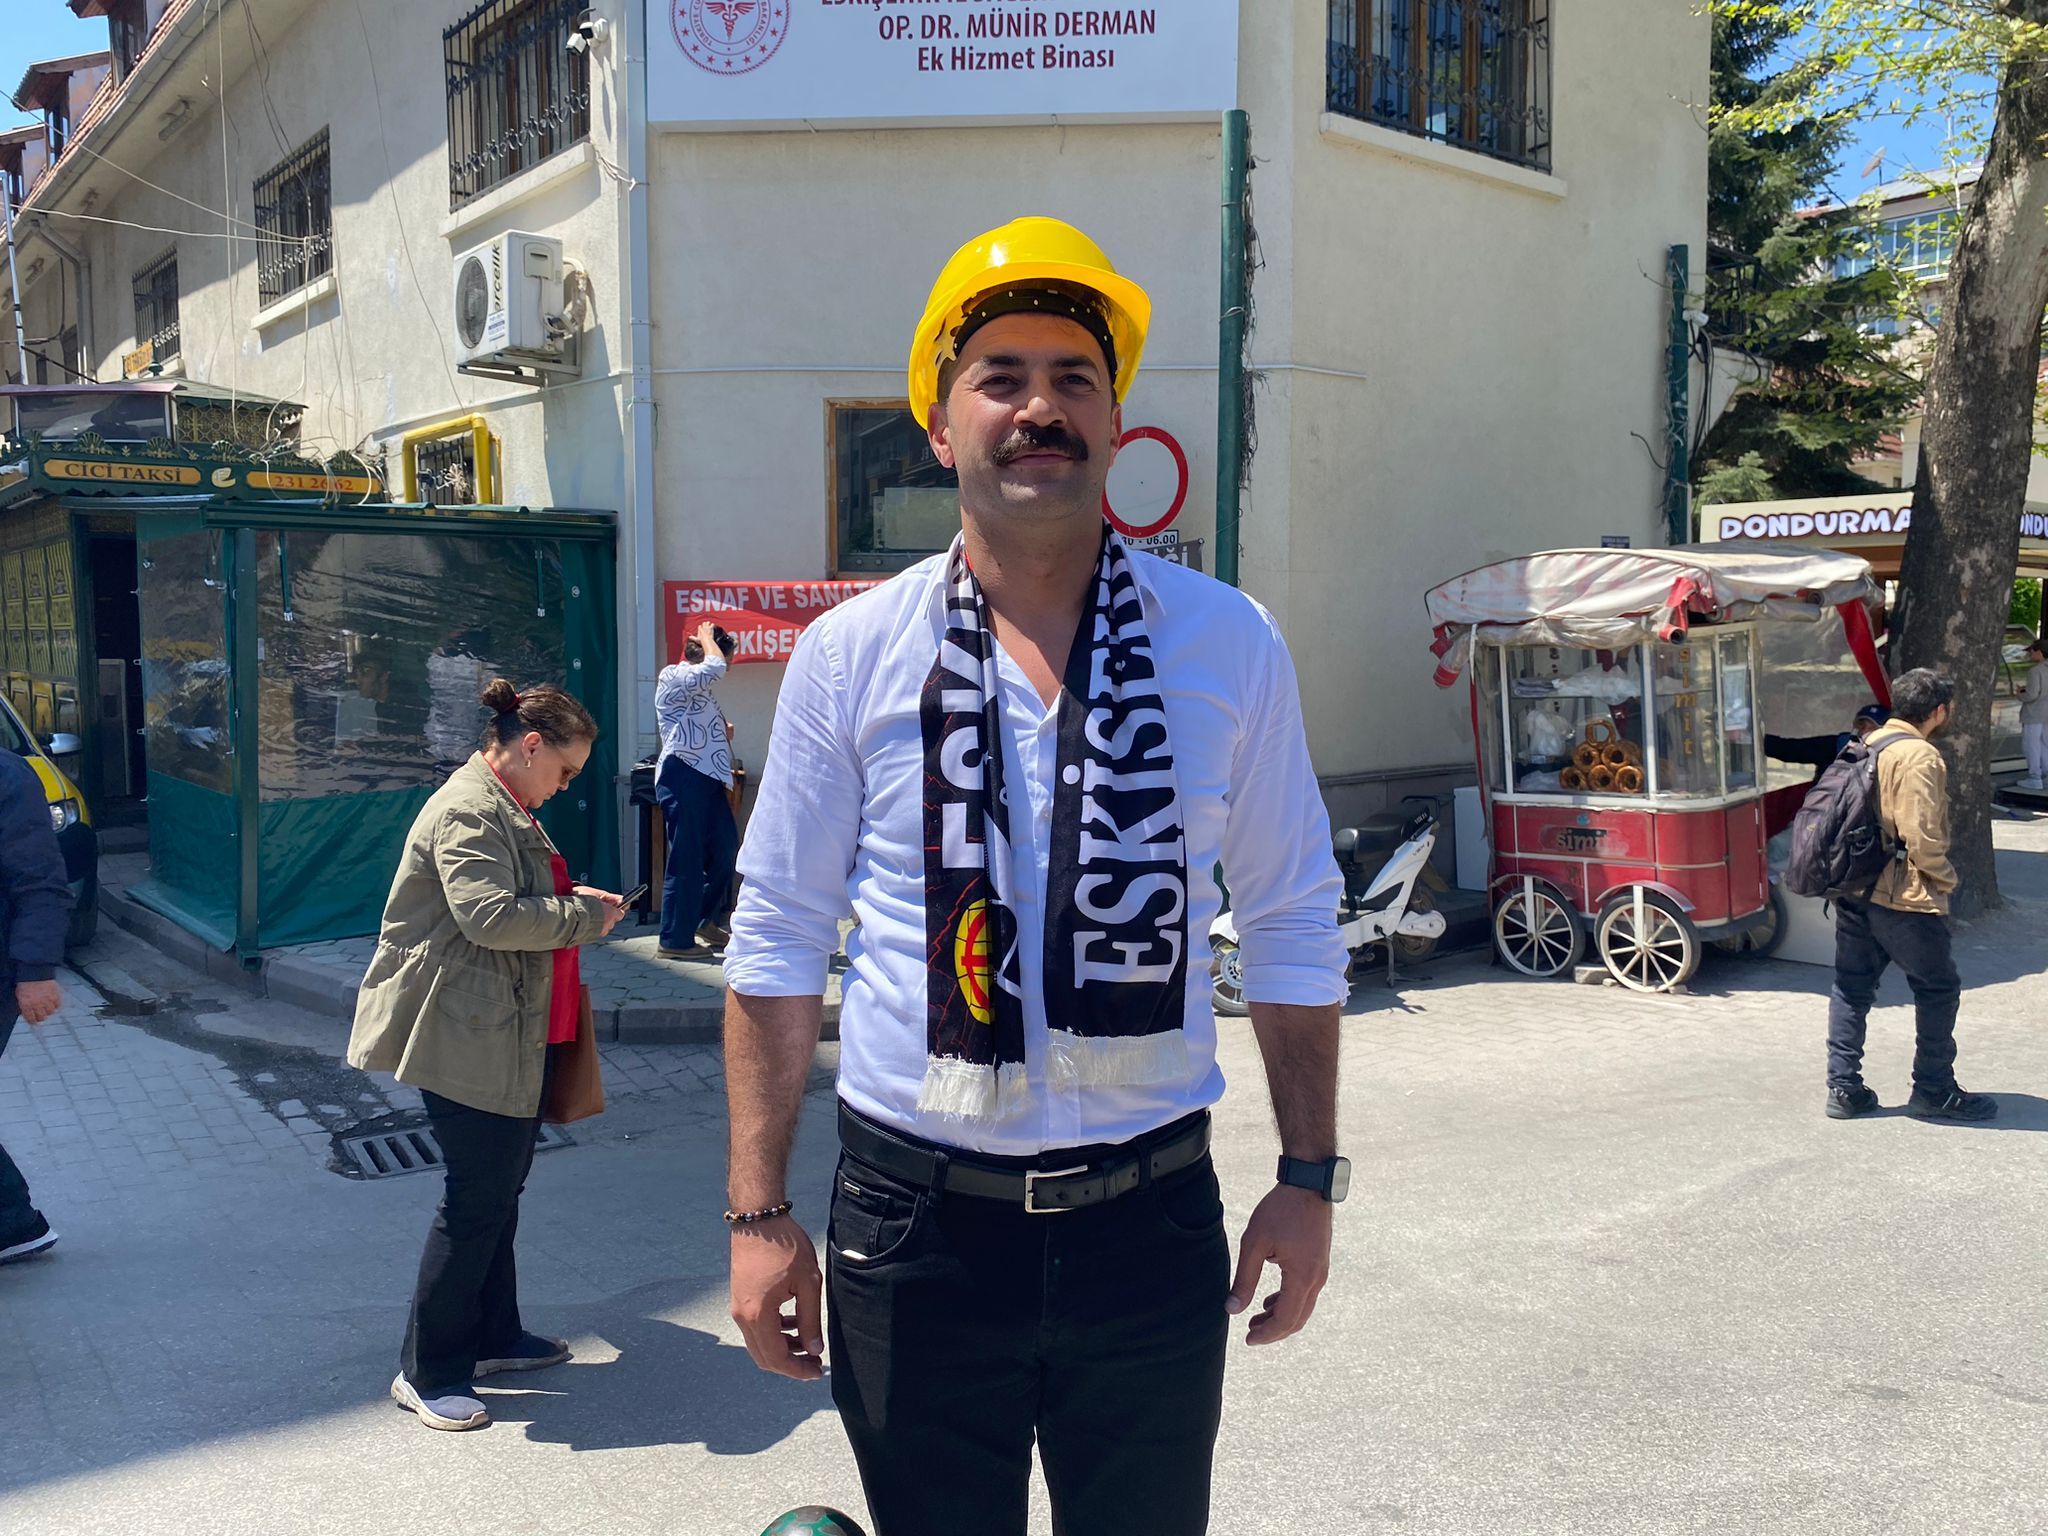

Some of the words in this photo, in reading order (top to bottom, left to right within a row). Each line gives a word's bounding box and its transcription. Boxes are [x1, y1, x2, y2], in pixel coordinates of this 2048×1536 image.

[879, 15, 914, 40] OP.
[921, 14, 960, 39] DR.
[967, 7, 1047, 38] MÜNİR
[1055, 9, 1155, 37] DERMAN
[918, 46, 944, 71] Ek
[951, 46, 1035, 71] Hizmet
[1042, 44, 1114, 69] Binası
[64, 462, 113, 478] CİCİ
[118, 466, 182, 482] TAKSİ
[275, 476, 303, 488] 231
[1721, 508, 1912, 540] DONDURMA
[1146, 535, 1176, 545] 06.00
[676, 587, 750, 614] ESNAF
[756, 586, 788, 610] VE
[793, 583, 878, 608] SANAT
